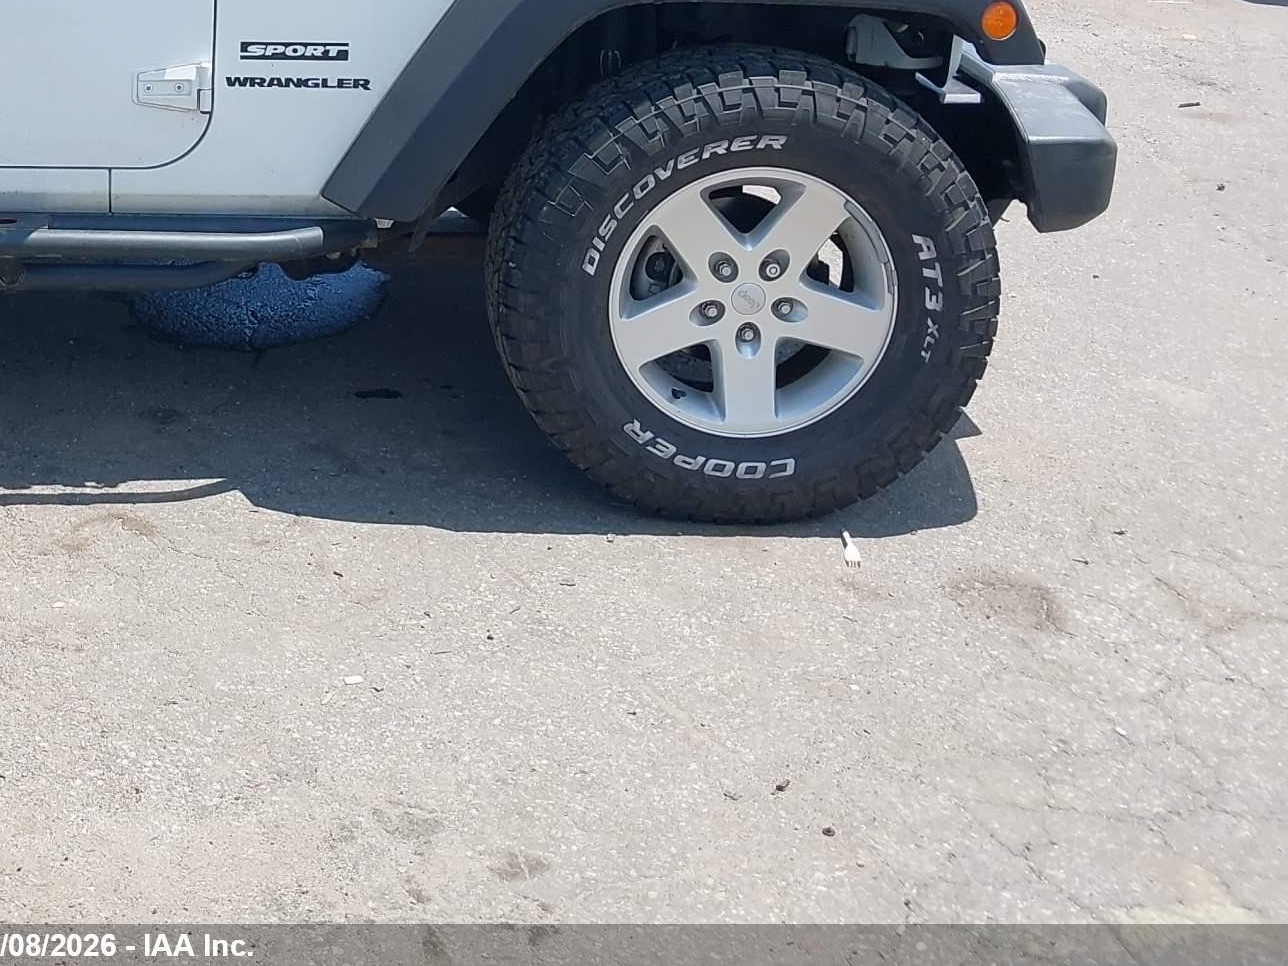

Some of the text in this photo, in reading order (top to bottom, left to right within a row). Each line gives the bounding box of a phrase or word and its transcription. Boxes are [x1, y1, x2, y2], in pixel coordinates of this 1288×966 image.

[246, 44, 346, 56] SPORT
[225, 76, 371, 90] WRANGLER
[581, 135, 787, 277] DISCOVERER
[912, 234, 944, 312] AT3
[623, 418, 796, 480] COOPER
